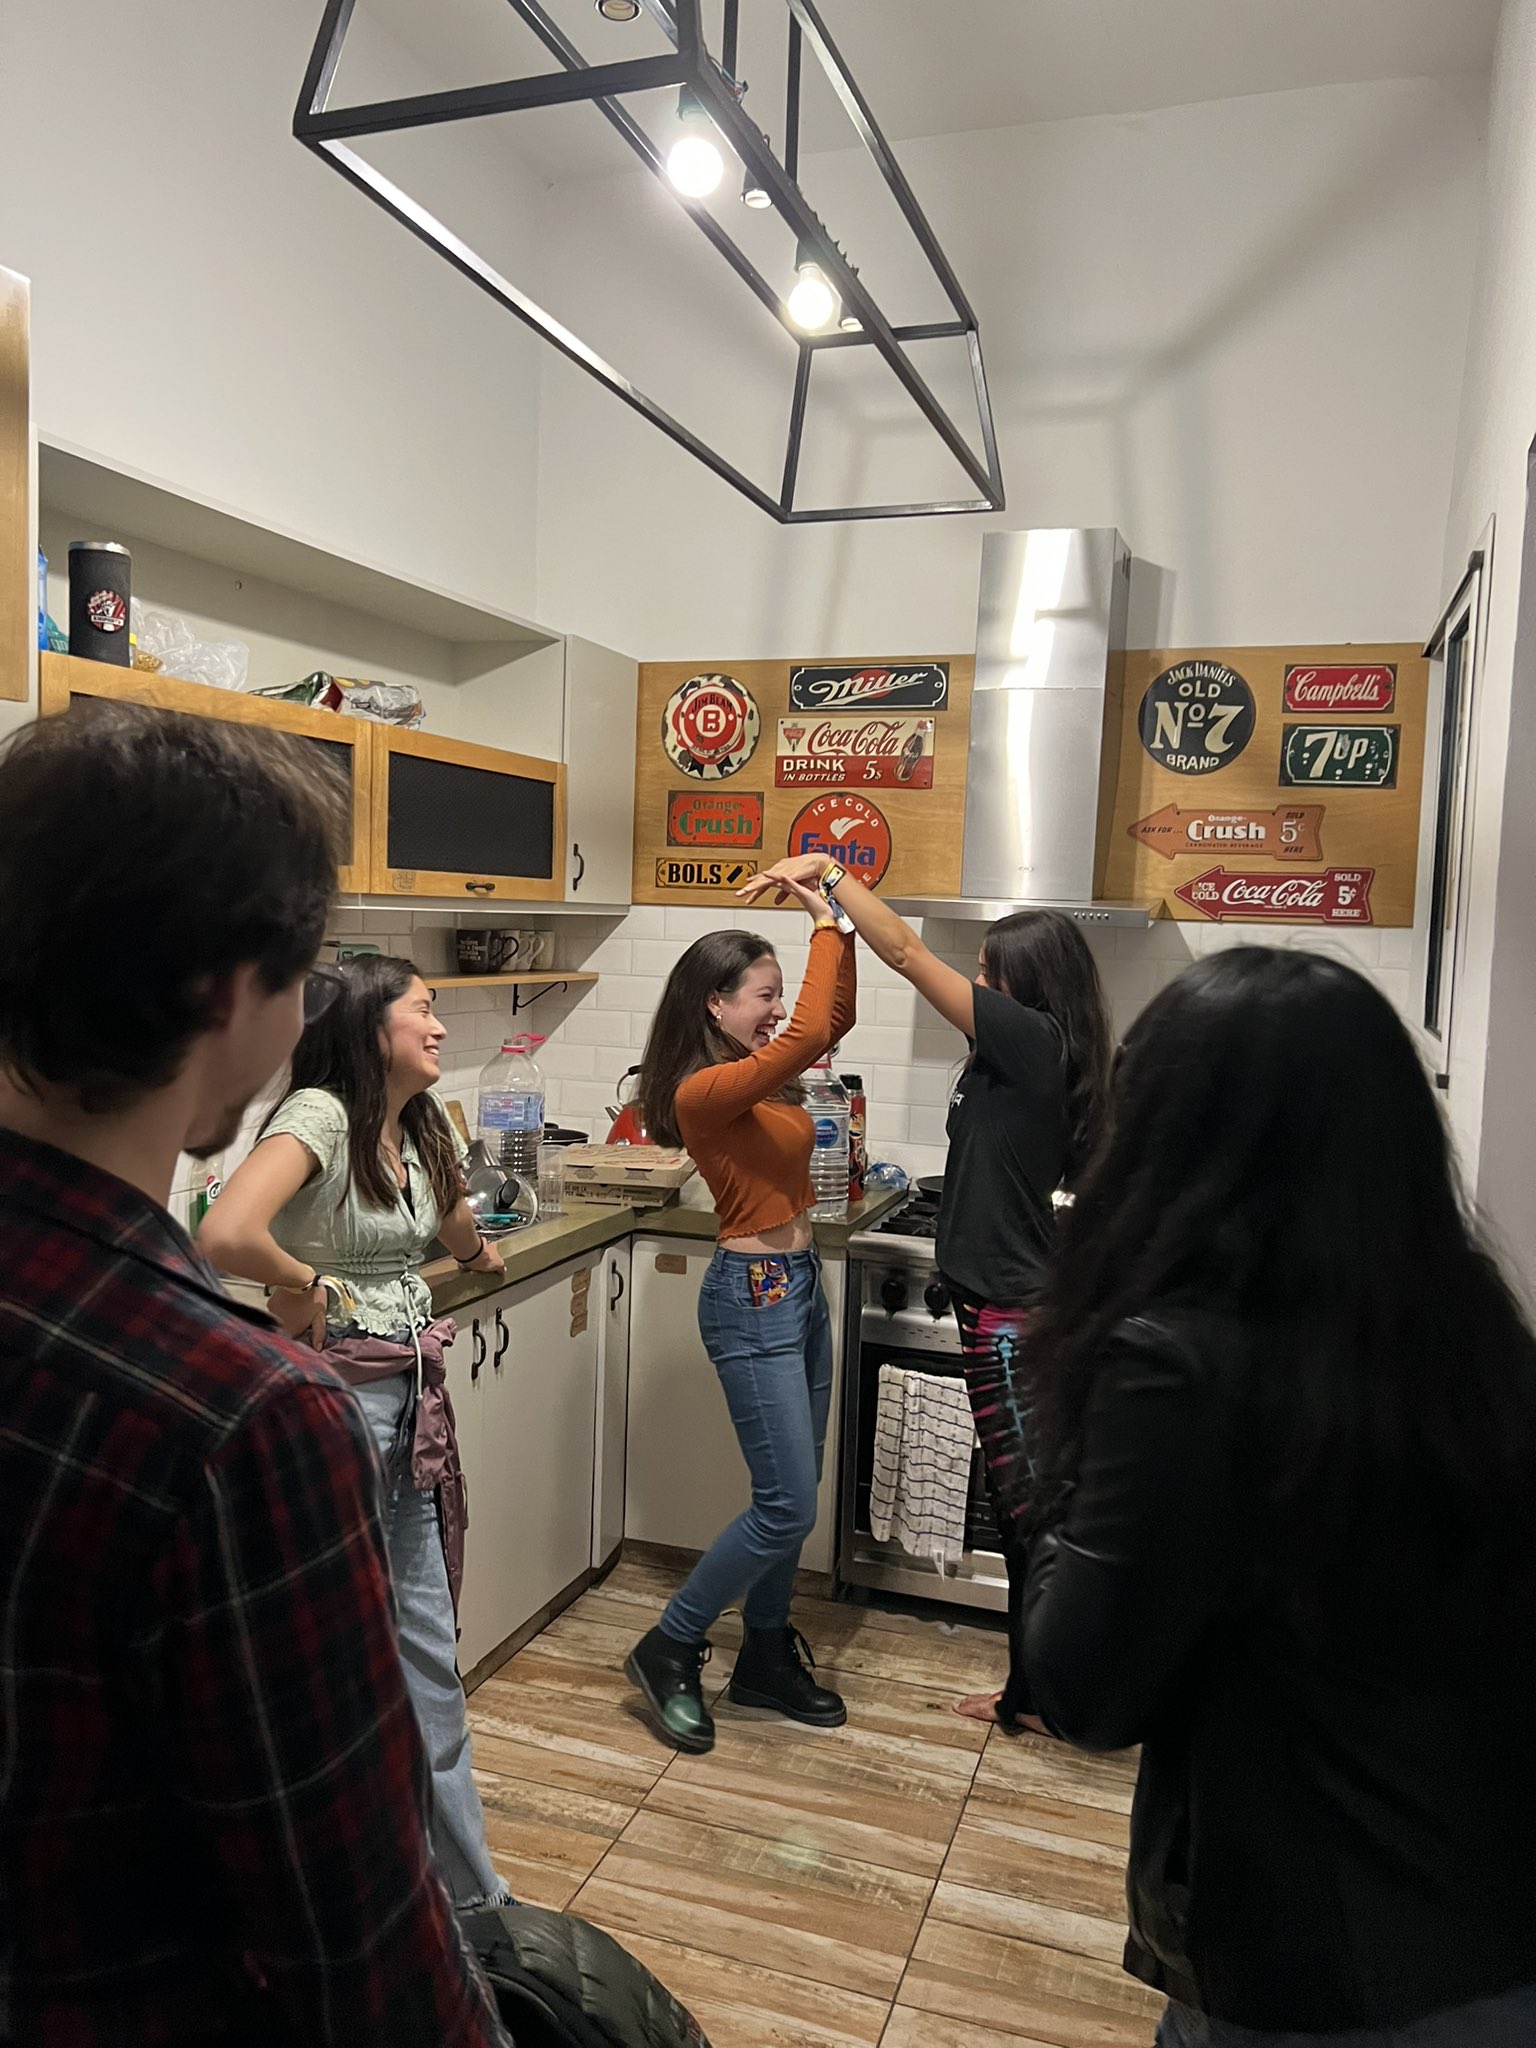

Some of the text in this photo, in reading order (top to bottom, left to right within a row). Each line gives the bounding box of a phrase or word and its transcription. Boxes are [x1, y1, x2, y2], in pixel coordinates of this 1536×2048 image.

[1167, 665, 1195, 686] JACK
[808, 672, 929, 707] Miller
[1178, 680, 1222, 698] OLD
[1294, 671, 1381, 707] Campbell's
[702, 710, 721, 732] B
[807, 720, 907, 756] Coca-Cola
[783, 758, 846, 773] DRINK
[1166, 753, 1220, 771] BRAND
[783, 773, 847, 782] IN BOTTLES
[679, 810, 753, 836] Crush
[812, 797, 880, 828] ICE COLD
[1285, 811, 1304, 820] SOLD
[1141, 825, 1156, 834] ASK
[1186, 819, 1266, 843] Crush
[668, 862, 722, 885] BOLS
[1334, 873, 1362, 883] SOLD
[1191, 890, 1220, 901] COLD
[1222, 878, 1328, 907] Coca-Cola
[1332, 908, 1362, 918] HERE
